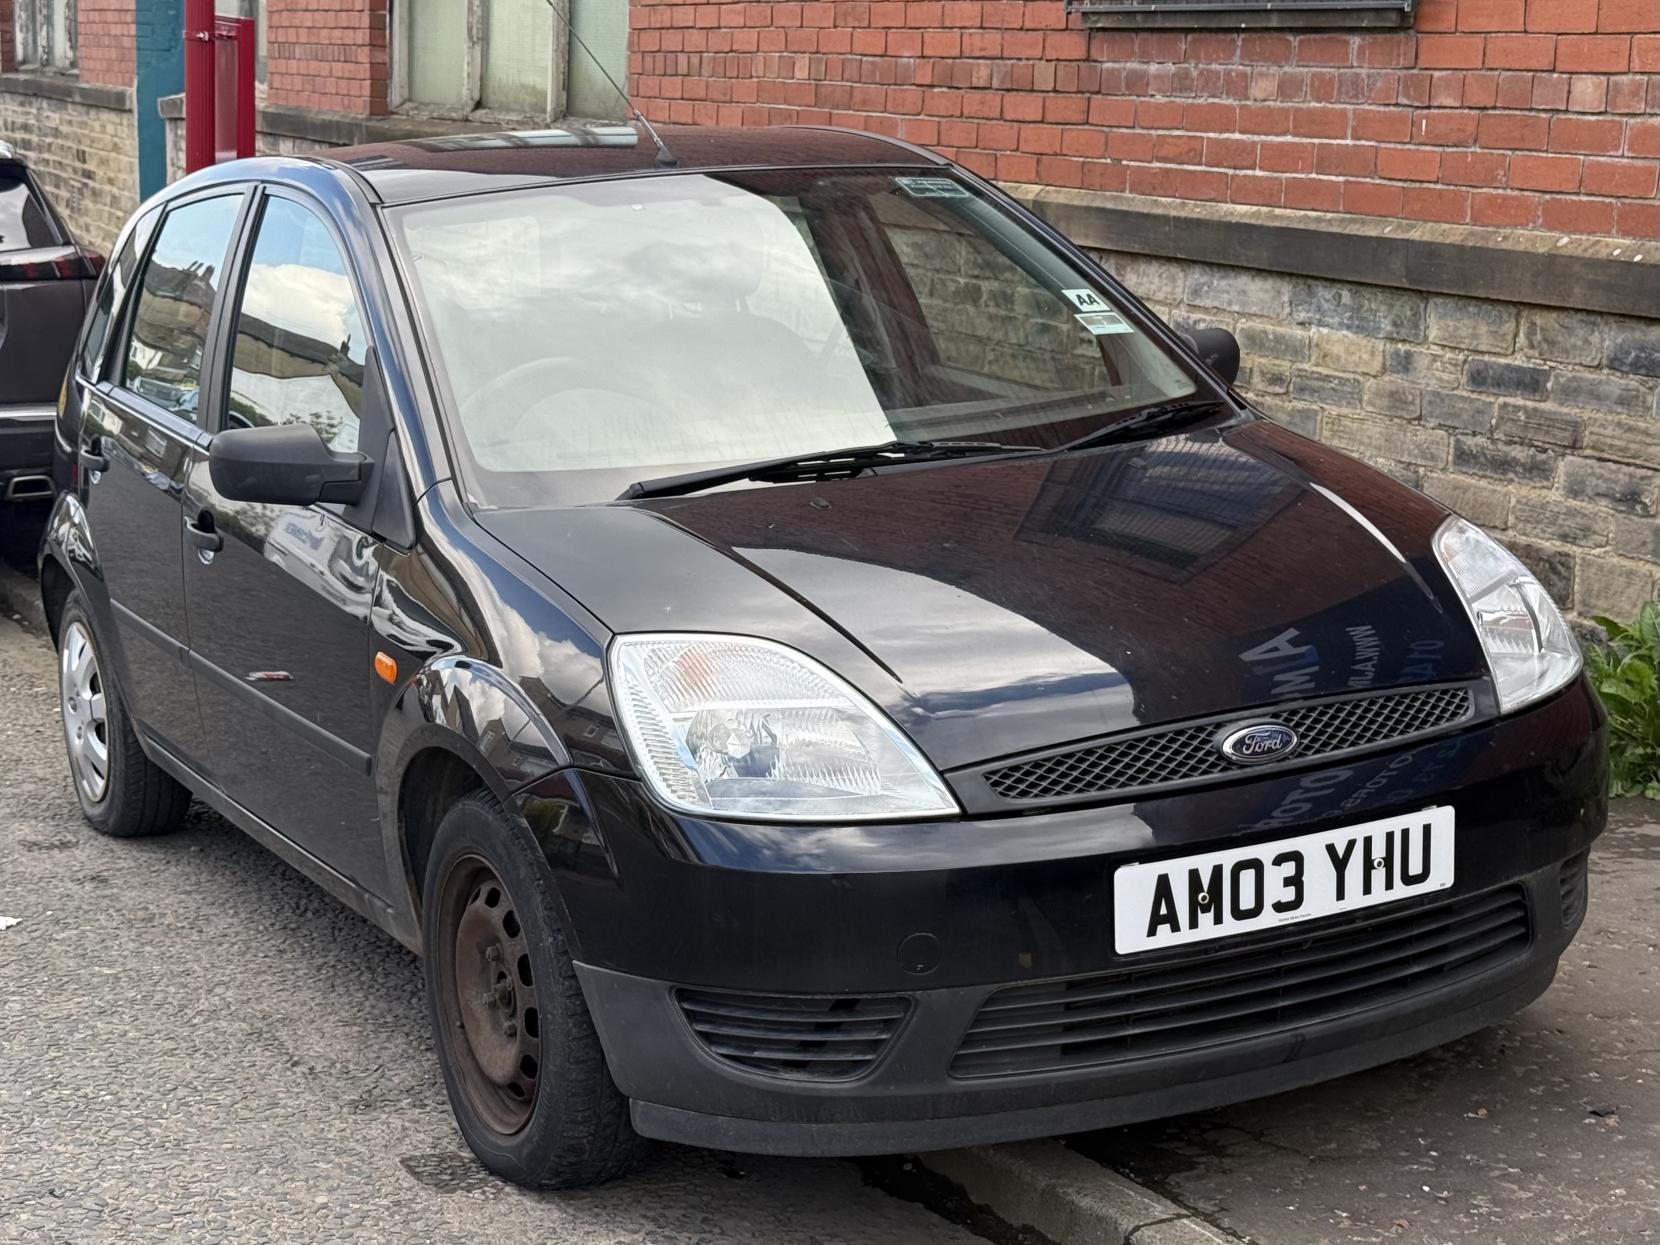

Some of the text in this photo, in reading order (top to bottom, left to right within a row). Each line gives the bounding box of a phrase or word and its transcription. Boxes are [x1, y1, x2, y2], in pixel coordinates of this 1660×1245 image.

[1076, 293, 1100, 306] AA
[1243, 732, 1283, 754] Ford
[1146, 822, 1432, 938] AM03 YHU
